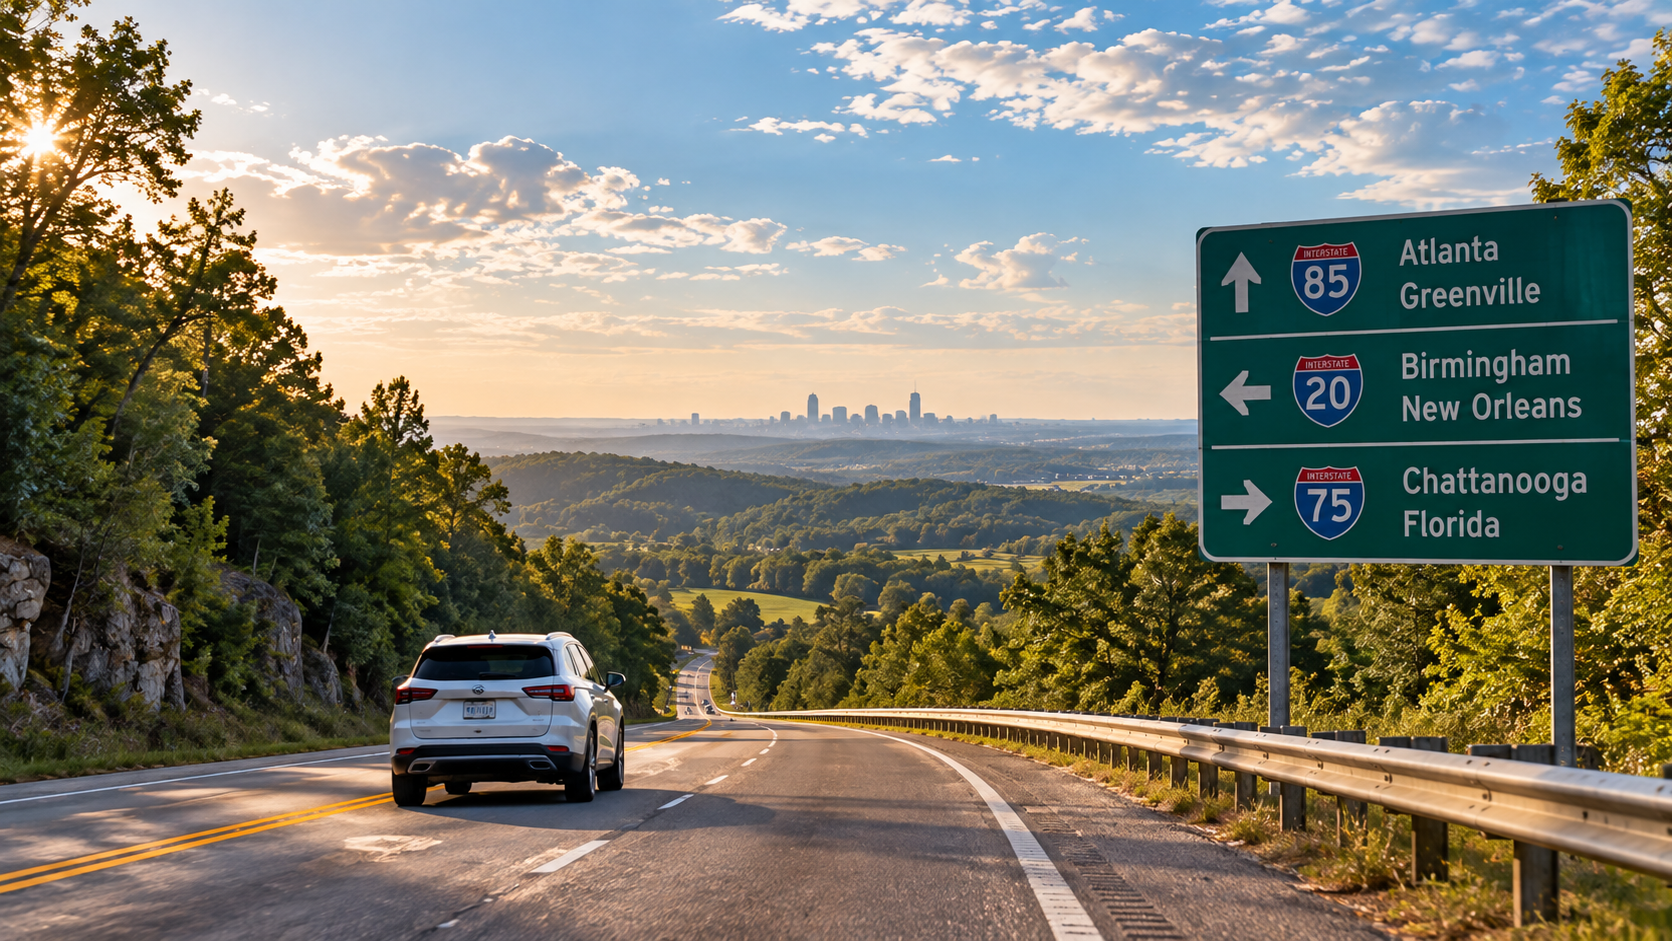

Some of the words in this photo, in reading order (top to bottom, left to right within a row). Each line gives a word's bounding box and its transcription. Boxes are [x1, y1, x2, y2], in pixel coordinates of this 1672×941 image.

[1304, 248, 1348, 258] INTERSTATE
[1399, 236, 1499, 266] Atlanta
[1304, 264, 1349, 299] 85
[1400, 277, 1541, 309] Greenville
[1305, 360, 1350, 369] INTERSTATE
[1402, 349, 1571, 384] Birmingham
[1306, 375, 1351, 410] 20
[1402, 395, 1460, 421] New
[1472, 392, 1582, 420] Orleans
[1307, 471, 1352, 480] INTERSTATE
[1403, 467, 1587, 501] Chattanooga
[1307, 488, 1352, 522] 75
[1404, 510, 1500, 538] Florida
